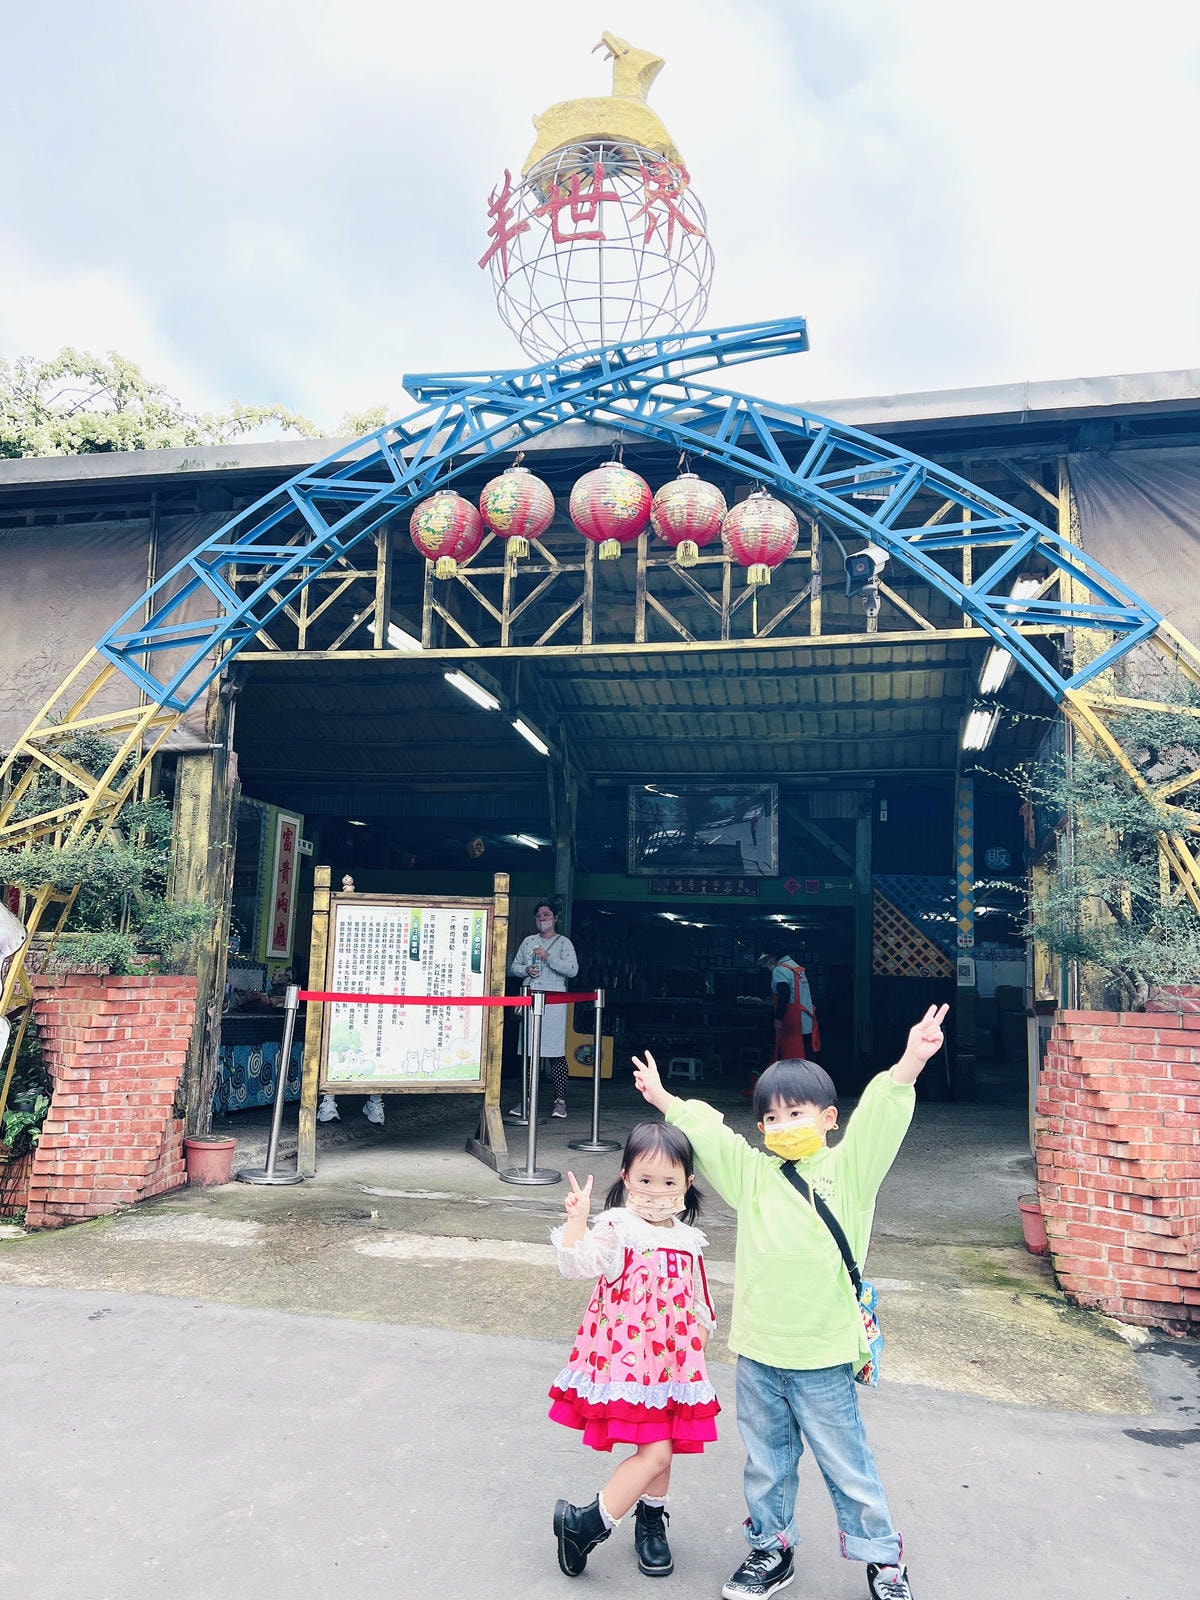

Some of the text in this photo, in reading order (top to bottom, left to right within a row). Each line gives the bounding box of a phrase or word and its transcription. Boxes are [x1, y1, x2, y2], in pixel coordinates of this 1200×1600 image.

[477, 161, 706, 283] 羊世界
[987, 848, 1010, 867] 販
